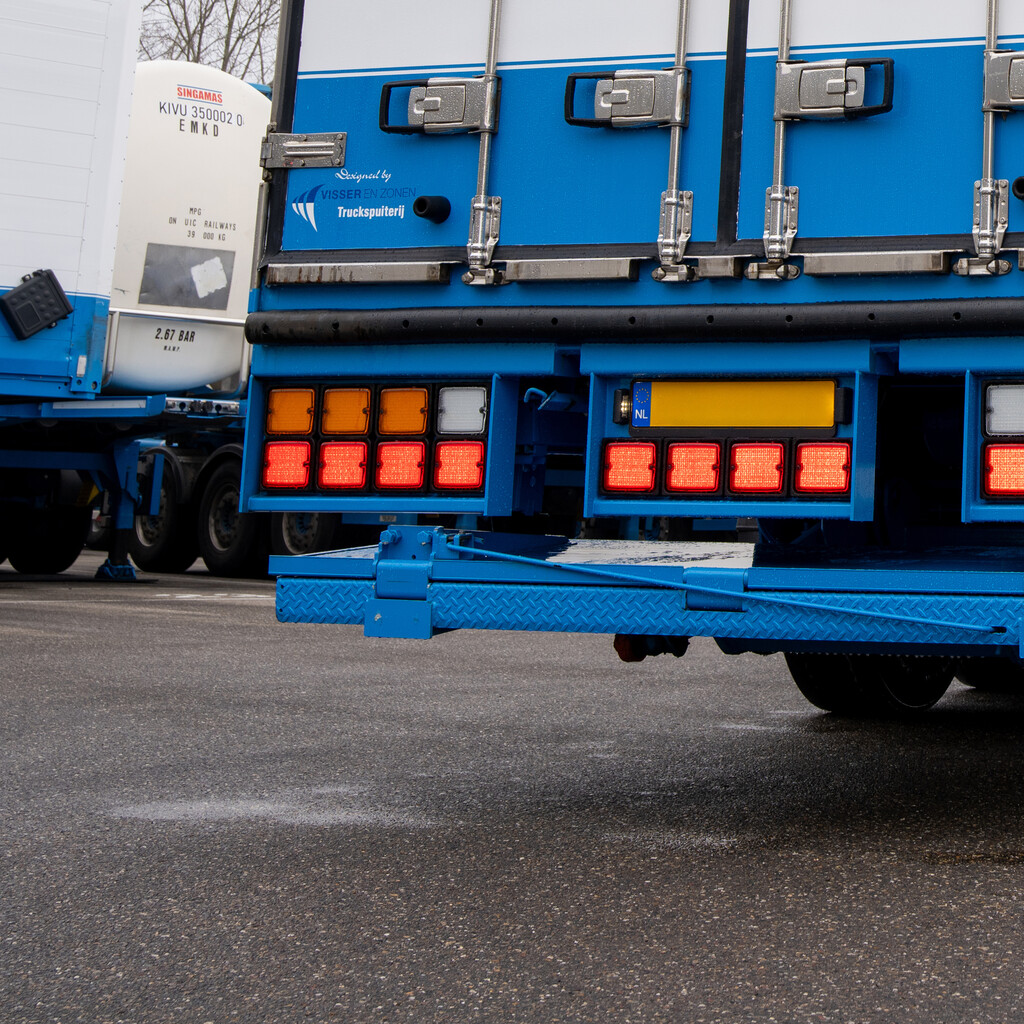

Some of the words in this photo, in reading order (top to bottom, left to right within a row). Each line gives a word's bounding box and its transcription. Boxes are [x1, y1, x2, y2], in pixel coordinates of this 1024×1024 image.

[177, 87, 223, 103] SINGAMAS
[159, 101, 187, 116] KIVU
[191, 106, 233, 124] 350002
[335, 168, 381, 183] Designed
[381, 169, 392, 183] by
[321, 189, 362, 200] VISSER
[364, 188, 377, 199] EN
[380, 187, 417, 198] ZONEN
[337, 205, 405, 219] Truckspuiterij
[184, 218, 197, 227] UIC
[203, 220, 237, 231] RAILWAYS
[187, 230, 196, 238] 39
[218, 233, 226, 241] KG
[155, 327, 176, 341] 2.67
[178, 330, 196, 343] BAR
[634, 409, 649, 419] NL
